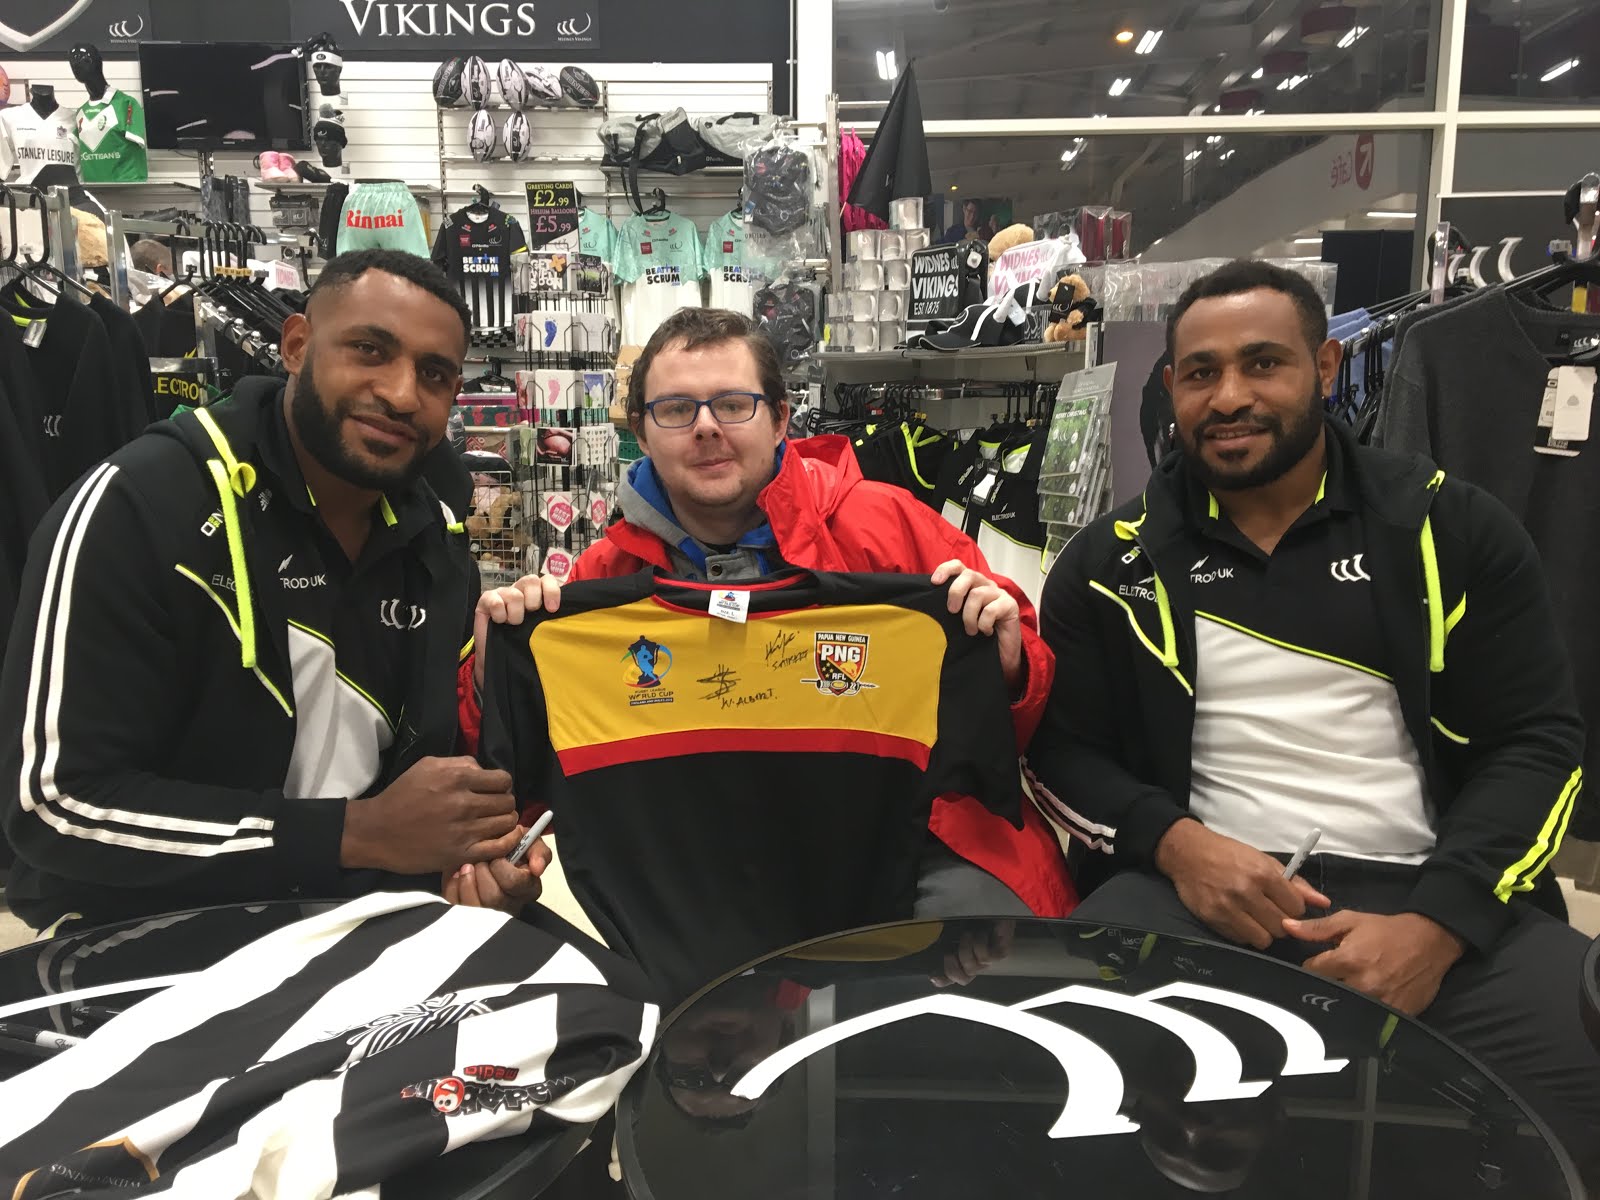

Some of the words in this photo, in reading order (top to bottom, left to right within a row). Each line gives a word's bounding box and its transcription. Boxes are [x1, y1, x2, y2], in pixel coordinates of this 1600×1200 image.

[340, 0, 536, 37] VIKINGS
[17, 147, 45, 161] STANLEY
[47, 149, 75, 164] LEISURE
[555, 182, 573, 190] CARDS
[533, 190, 569, 207] £2.99
[346, 209, 404, 230] Rinnai
[535, 215, 572, 233] £5.99
[914, 252, 950, 274] WIDNES
[1000, 248, 1041, 271] WIDNES
[463, 264, 499, 273] SCRUM
[646, 273, 680, 285] SCRUM
[912, 274, 959, 299] VIKINGS
[310, 574, 327, 587] UK
[1217, 568, 1234, 578] UK
[818, 633, 834, 641] PAPUA
[848, 635, 866, 643] GUINEA
[820, 644, 861, 663] PNG
